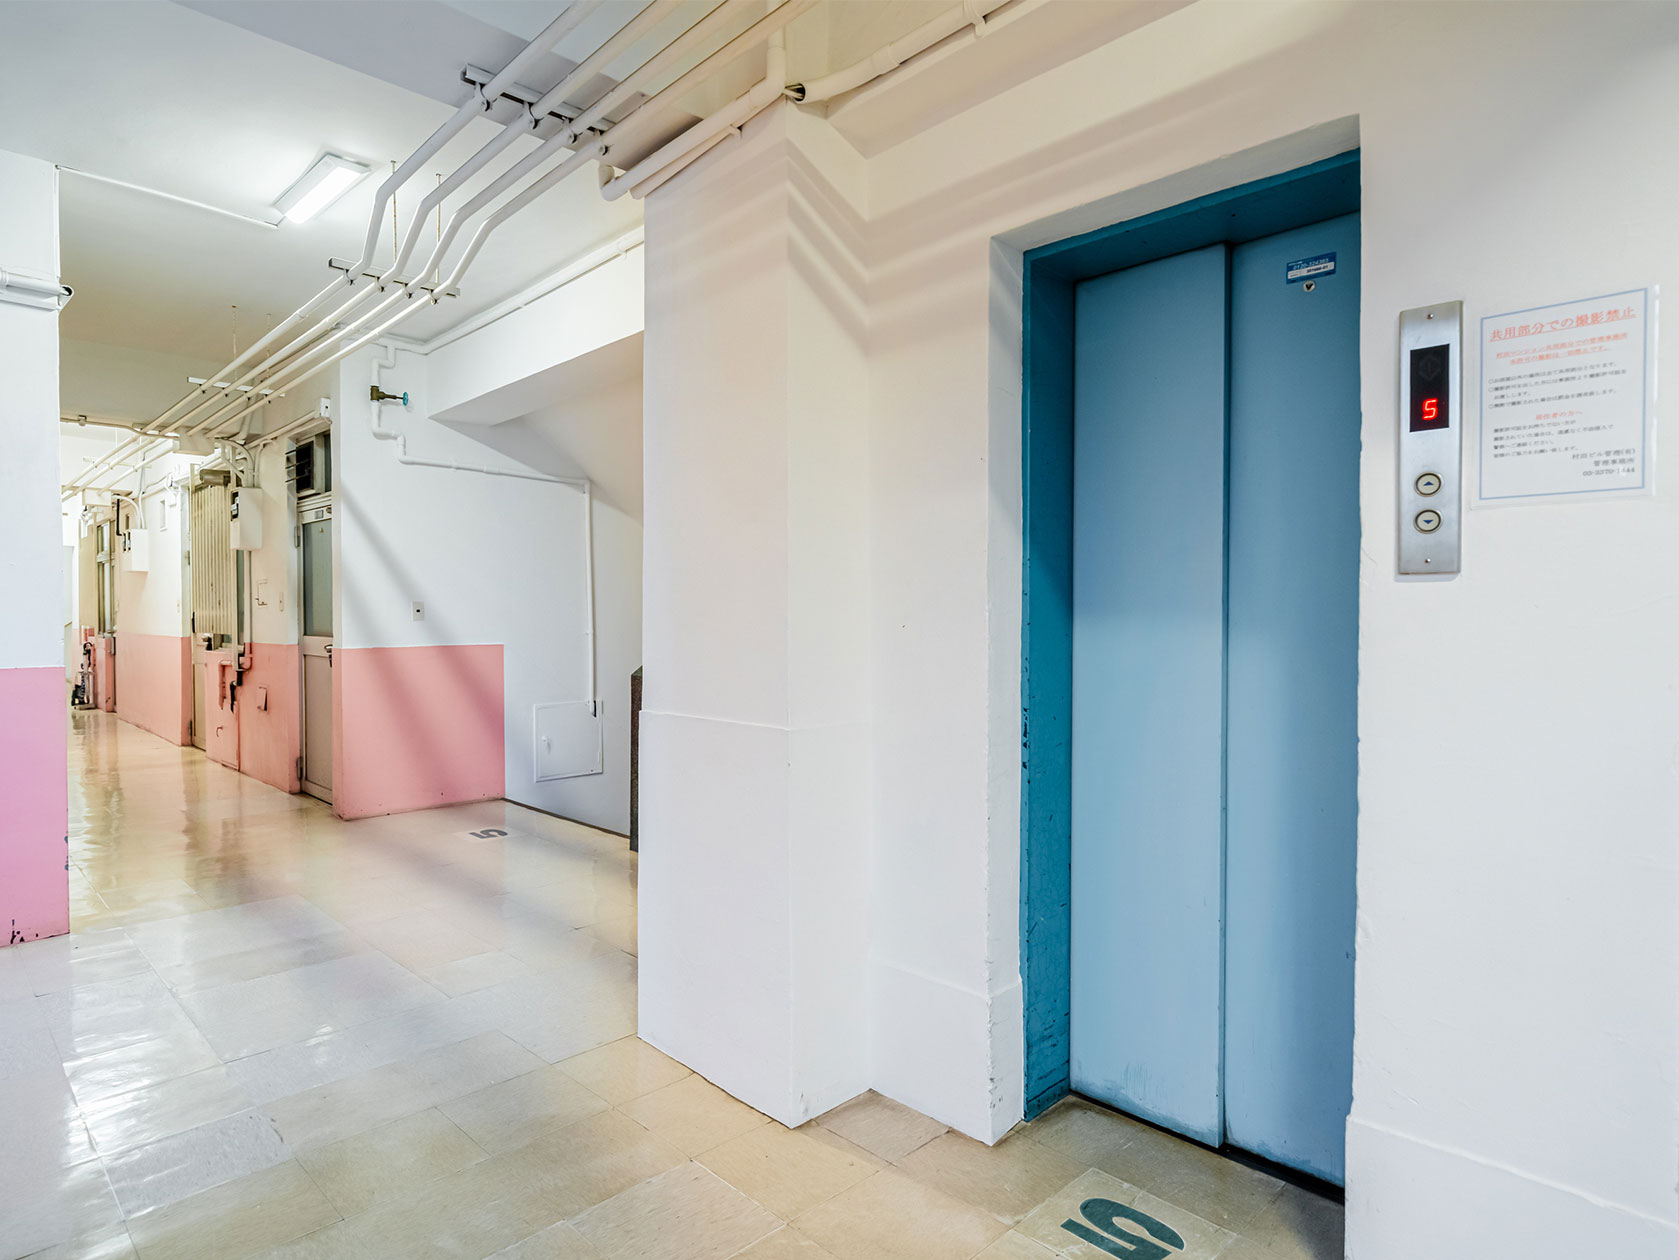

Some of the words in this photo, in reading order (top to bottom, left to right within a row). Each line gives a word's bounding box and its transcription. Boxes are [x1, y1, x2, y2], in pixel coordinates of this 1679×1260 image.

[1490, 306, 1635, 340] 共用部分での撮影禁止
[1422, 398, 1438, 420] 5
[468, 828, 508, 839] 5
[1060, 1197, 1185, 1260] 5
